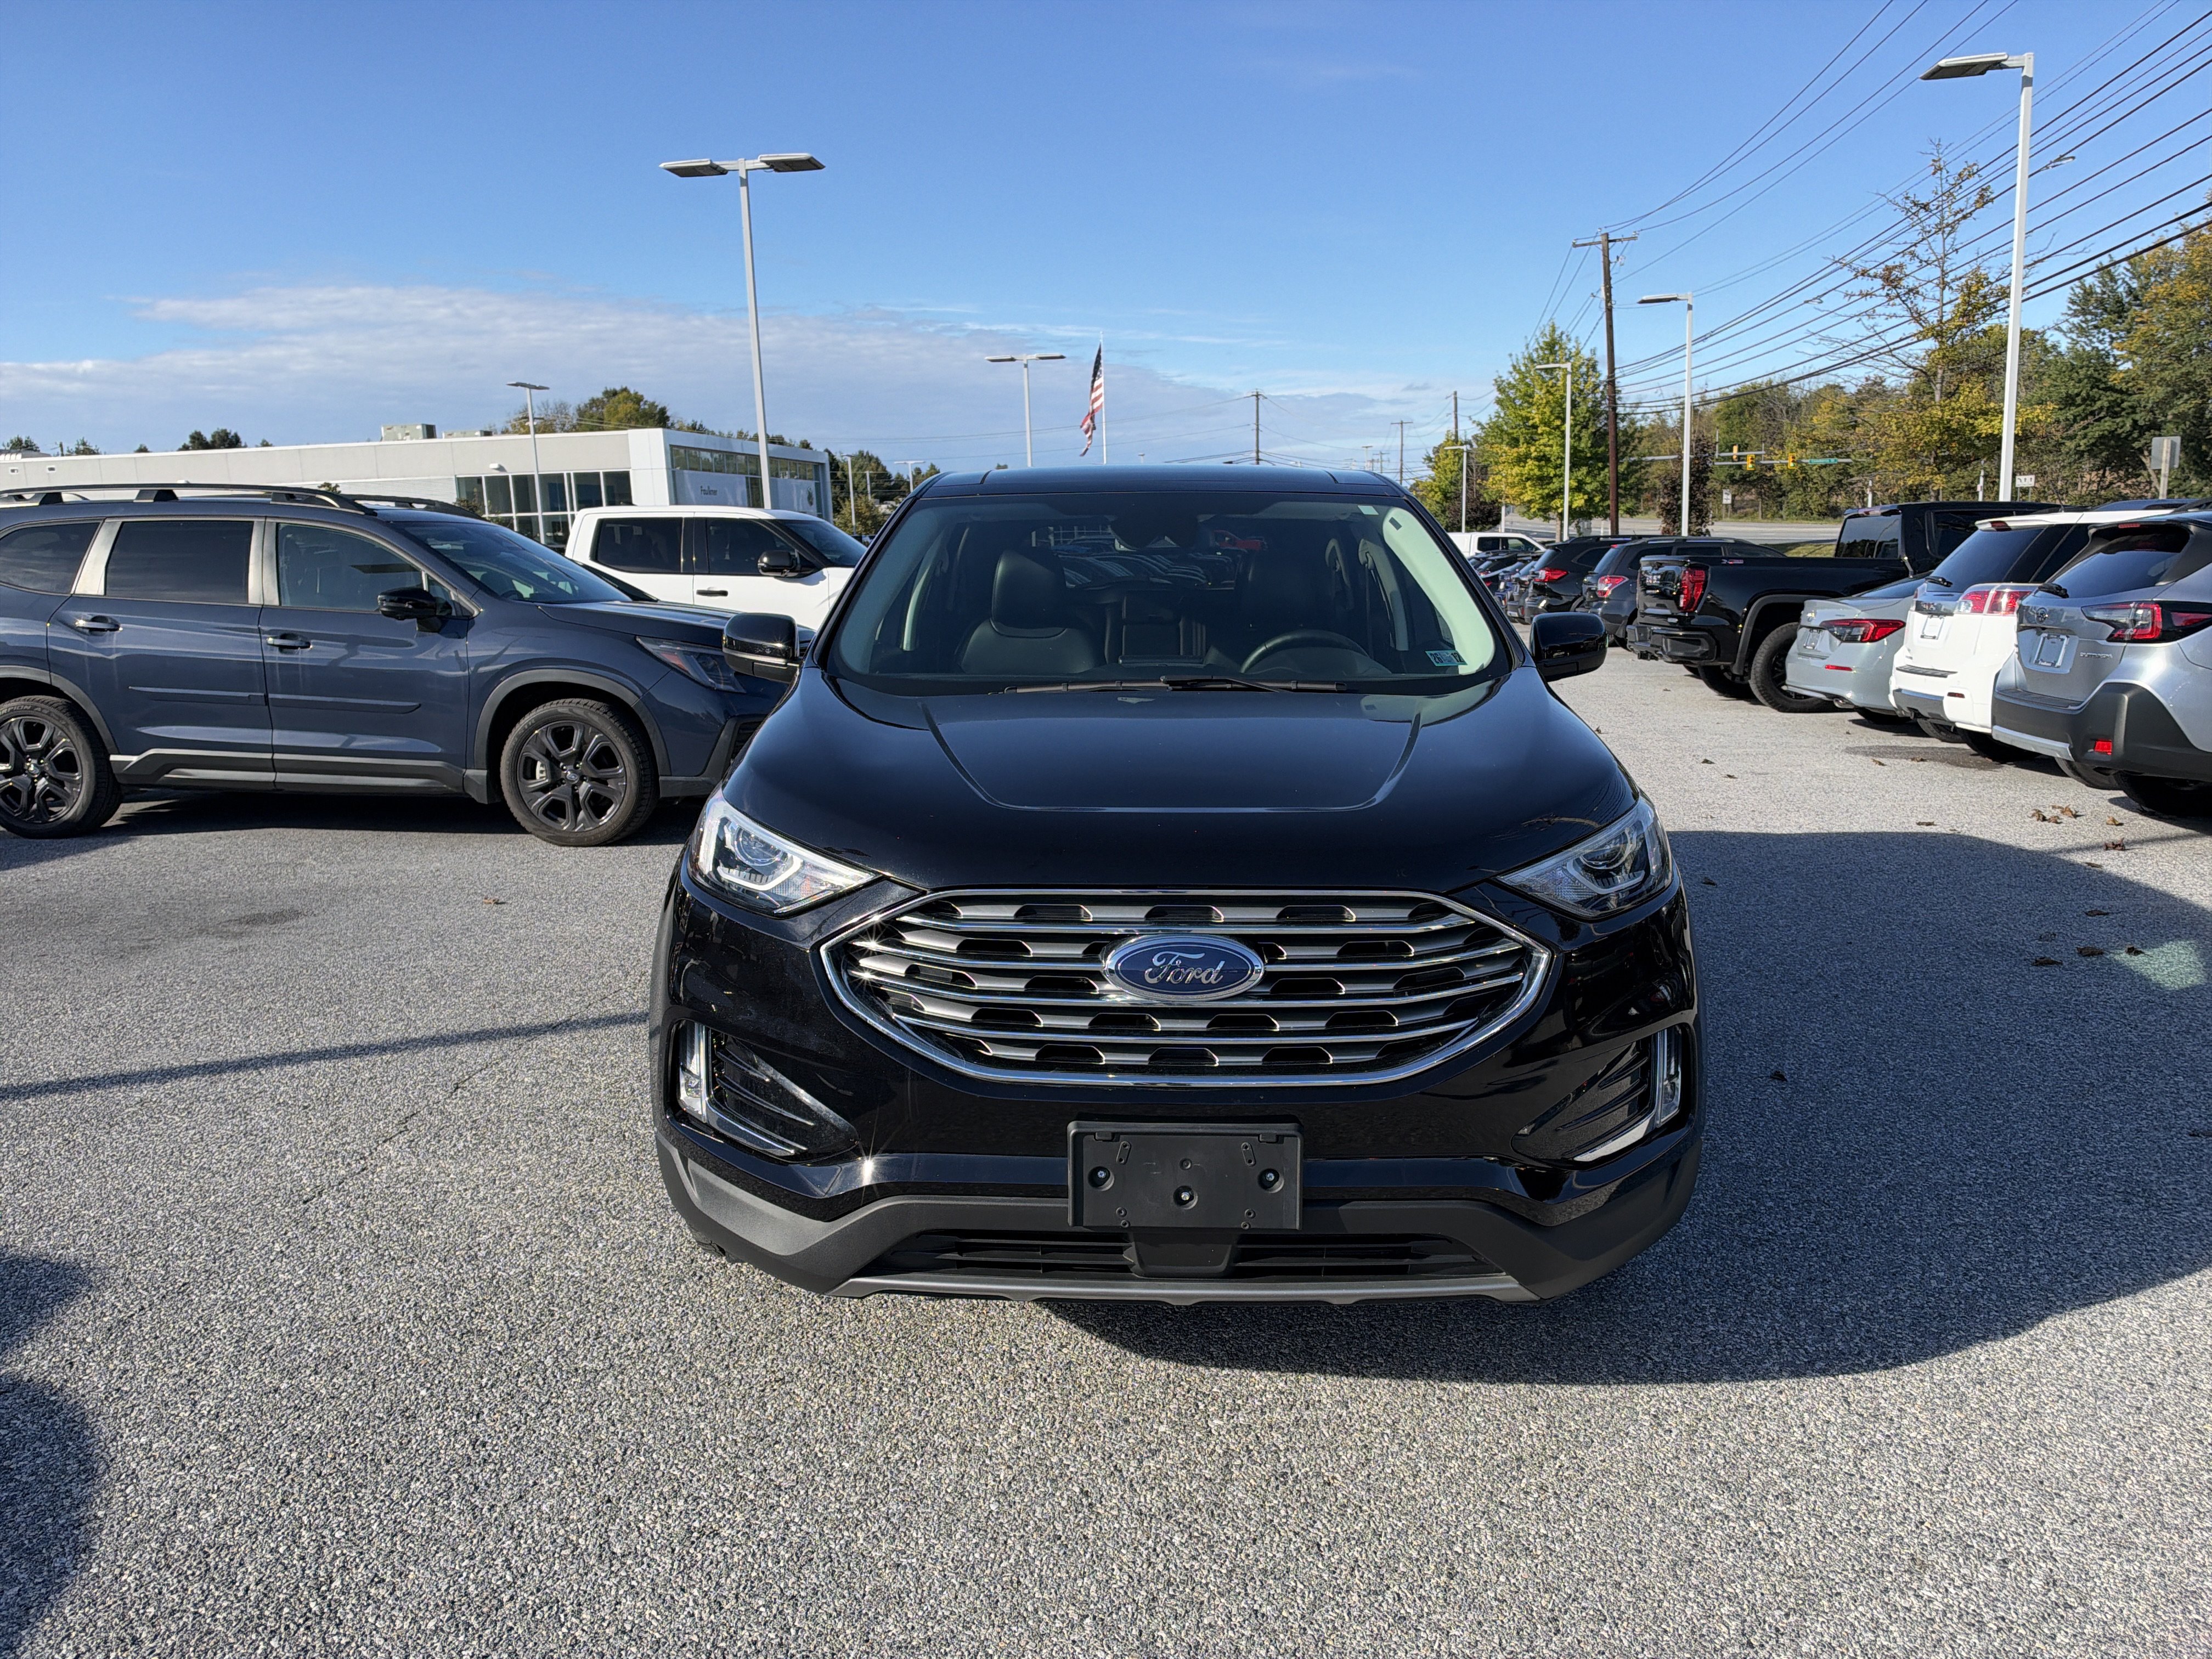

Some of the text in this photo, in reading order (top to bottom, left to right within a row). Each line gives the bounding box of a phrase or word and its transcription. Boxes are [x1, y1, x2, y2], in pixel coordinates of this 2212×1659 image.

[1430, 652, 1464, 664] 26 12
[0, 705, 32, 716] RPION
[1144, 951, 1225, 984] Ford
